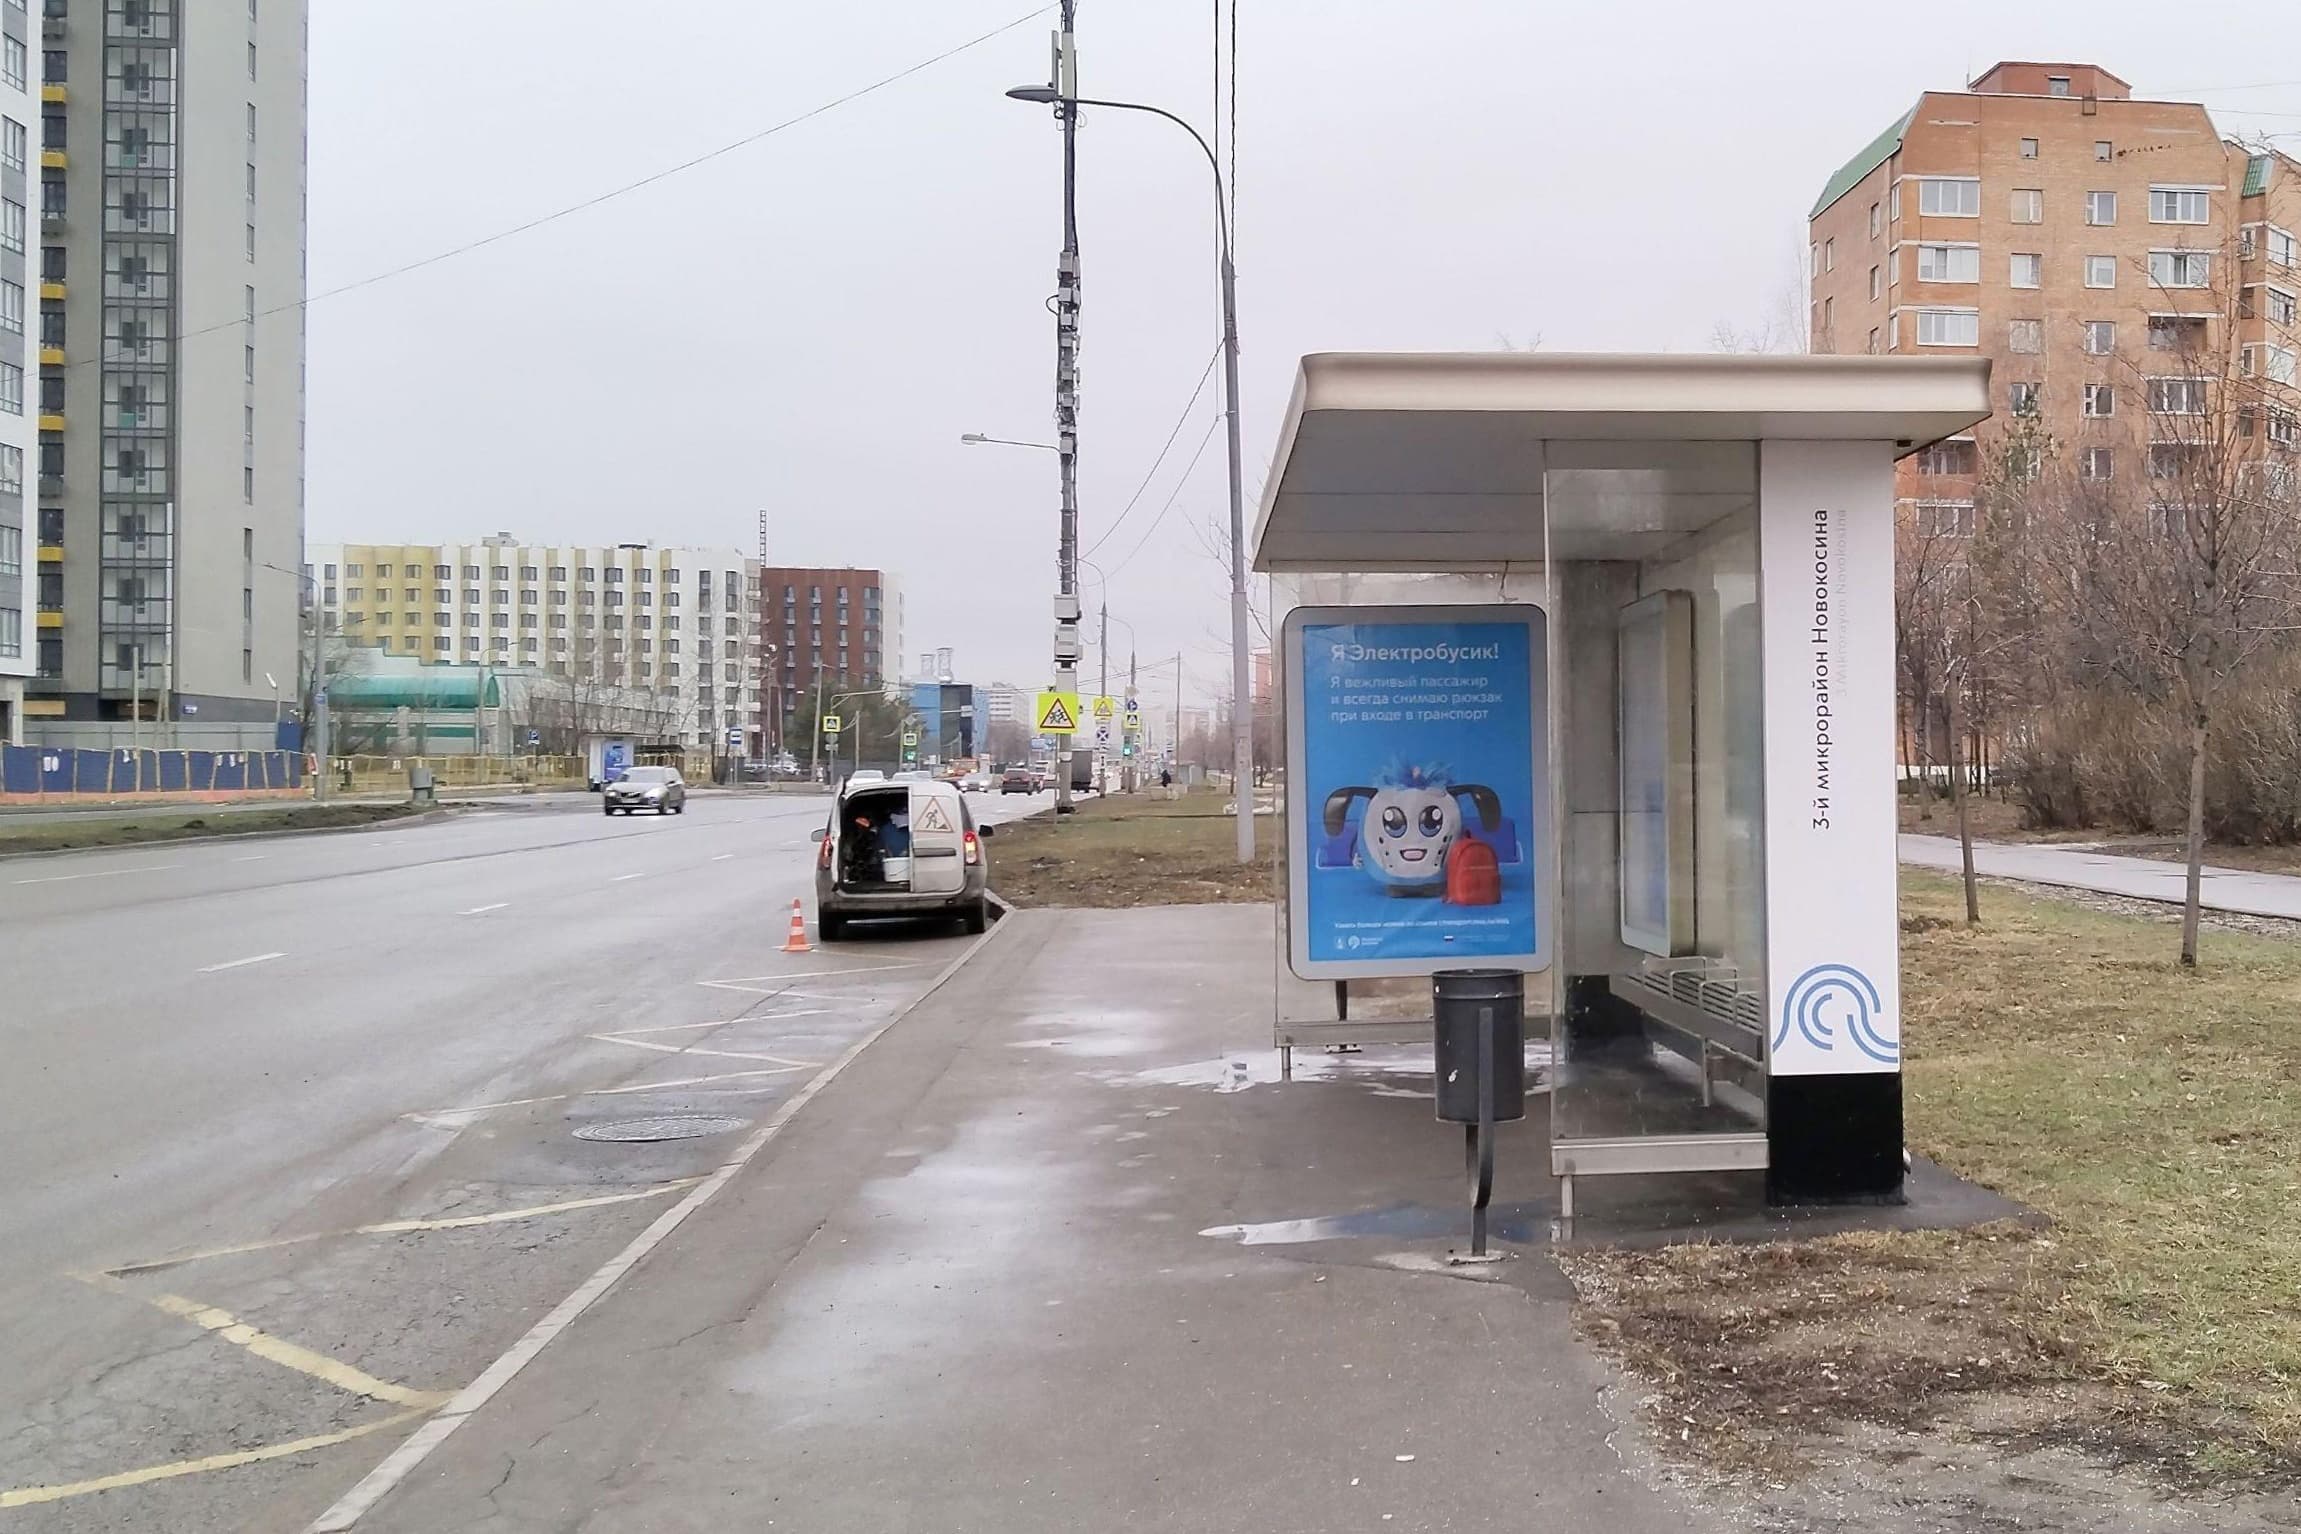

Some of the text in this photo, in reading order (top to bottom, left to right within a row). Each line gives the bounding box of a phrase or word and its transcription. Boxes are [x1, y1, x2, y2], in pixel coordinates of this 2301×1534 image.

[1833, 509, 1847, 594] Novokosina
[1331, 643, 1500, 664] Я Электробусик!
[1811, 509, 1833, 829] 3-й микрорайон Новокосина
[1330, 675, 1489, 689] Я вежливый пассажир
[1331, 692, 1503, 706] и всегда снимаю рюкзак
[1331, 708, 1489, 724] при входе в транспорт
